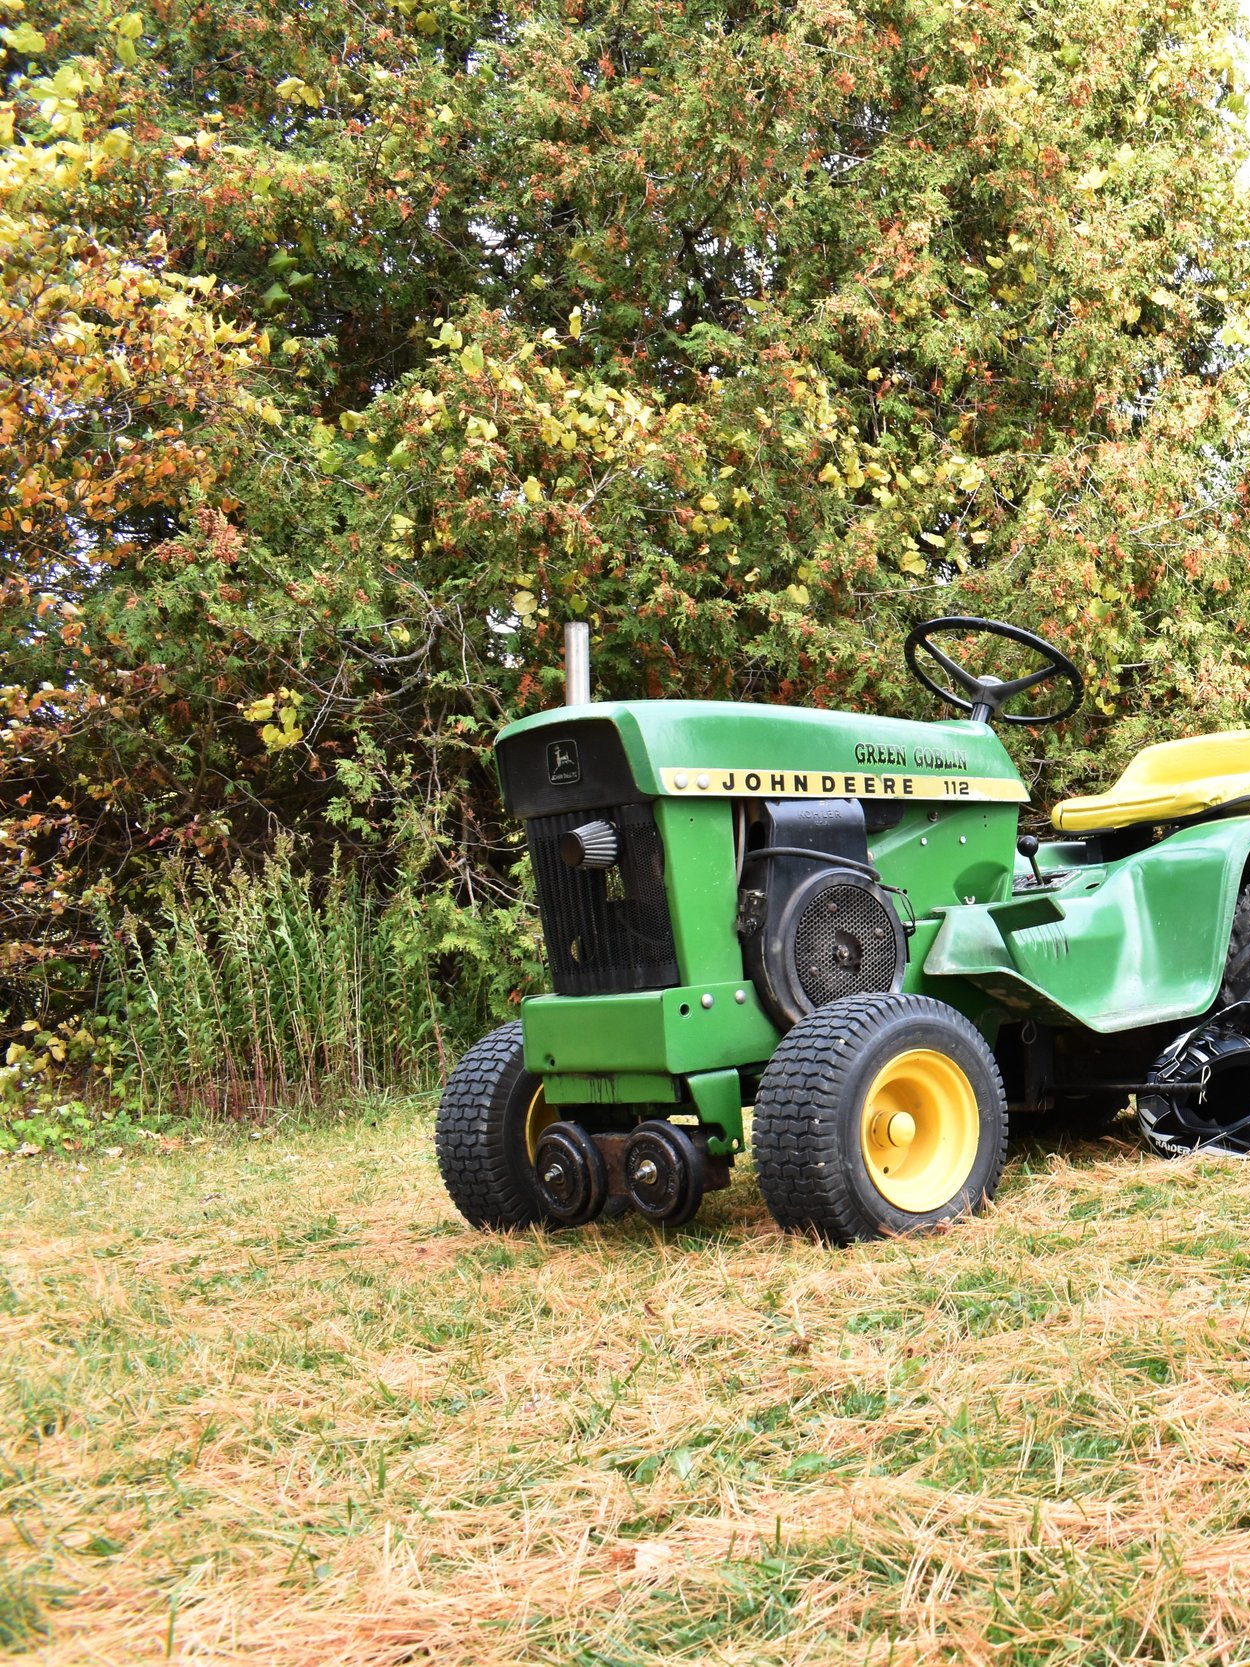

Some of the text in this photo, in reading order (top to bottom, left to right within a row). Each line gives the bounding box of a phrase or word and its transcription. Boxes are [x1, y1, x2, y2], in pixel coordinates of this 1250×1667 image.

[855, 742, 968, 771] GREEN GOBLIN
[722, 772, 970, 795] JOHN DEERE 112
[799, 810, 842, 819] KOHLER
[1155, 1140, 1191, 1155] RAIDER
